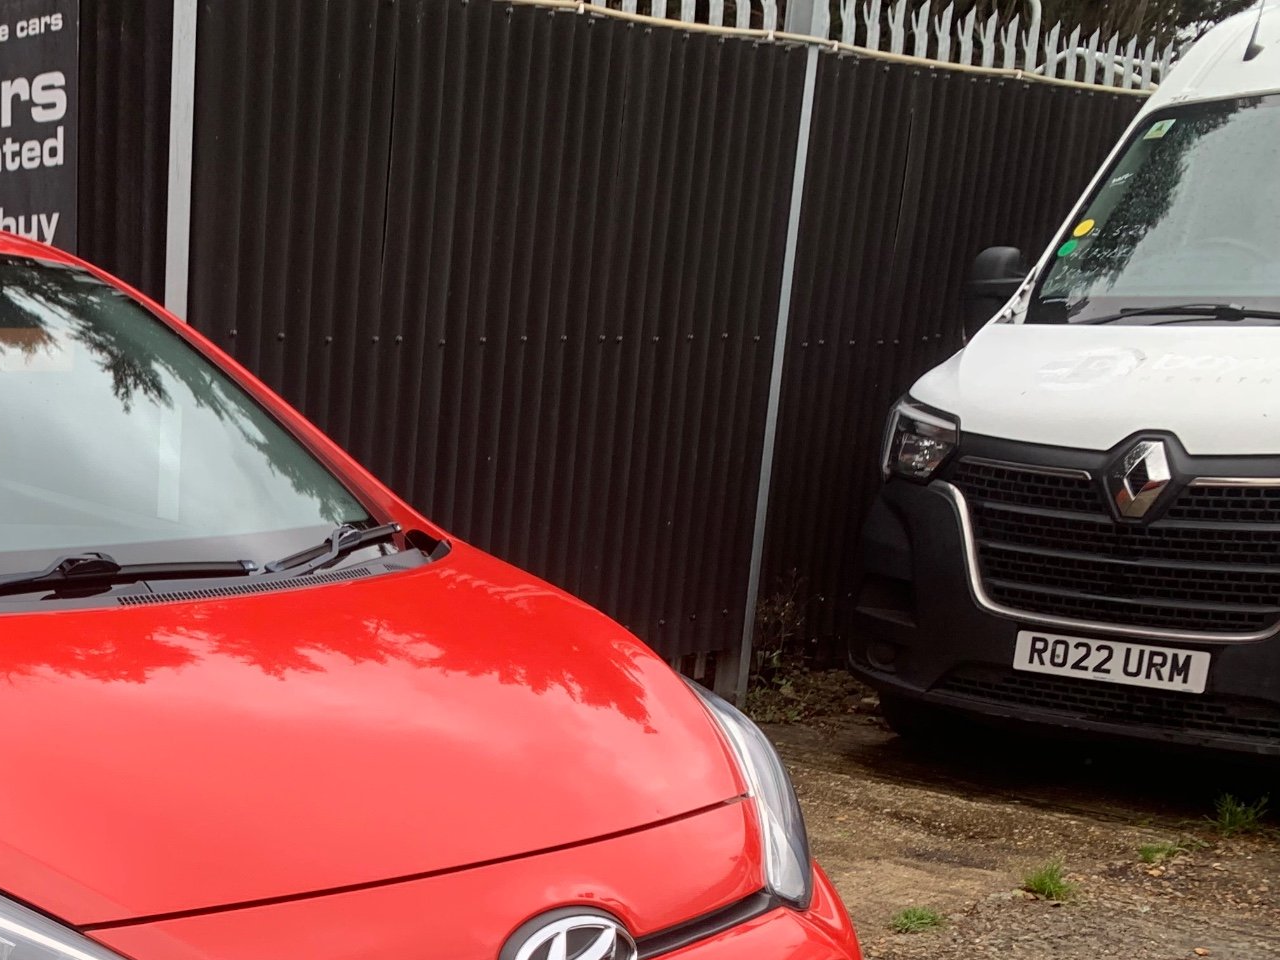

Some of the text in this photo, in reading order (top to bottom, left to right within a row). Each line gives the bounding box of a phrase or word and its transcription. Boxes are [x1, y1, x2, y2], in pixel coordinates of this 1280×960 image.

[16, 12, 63, 39] cars
[1028, 636, 1193, 685] RO22 URM
